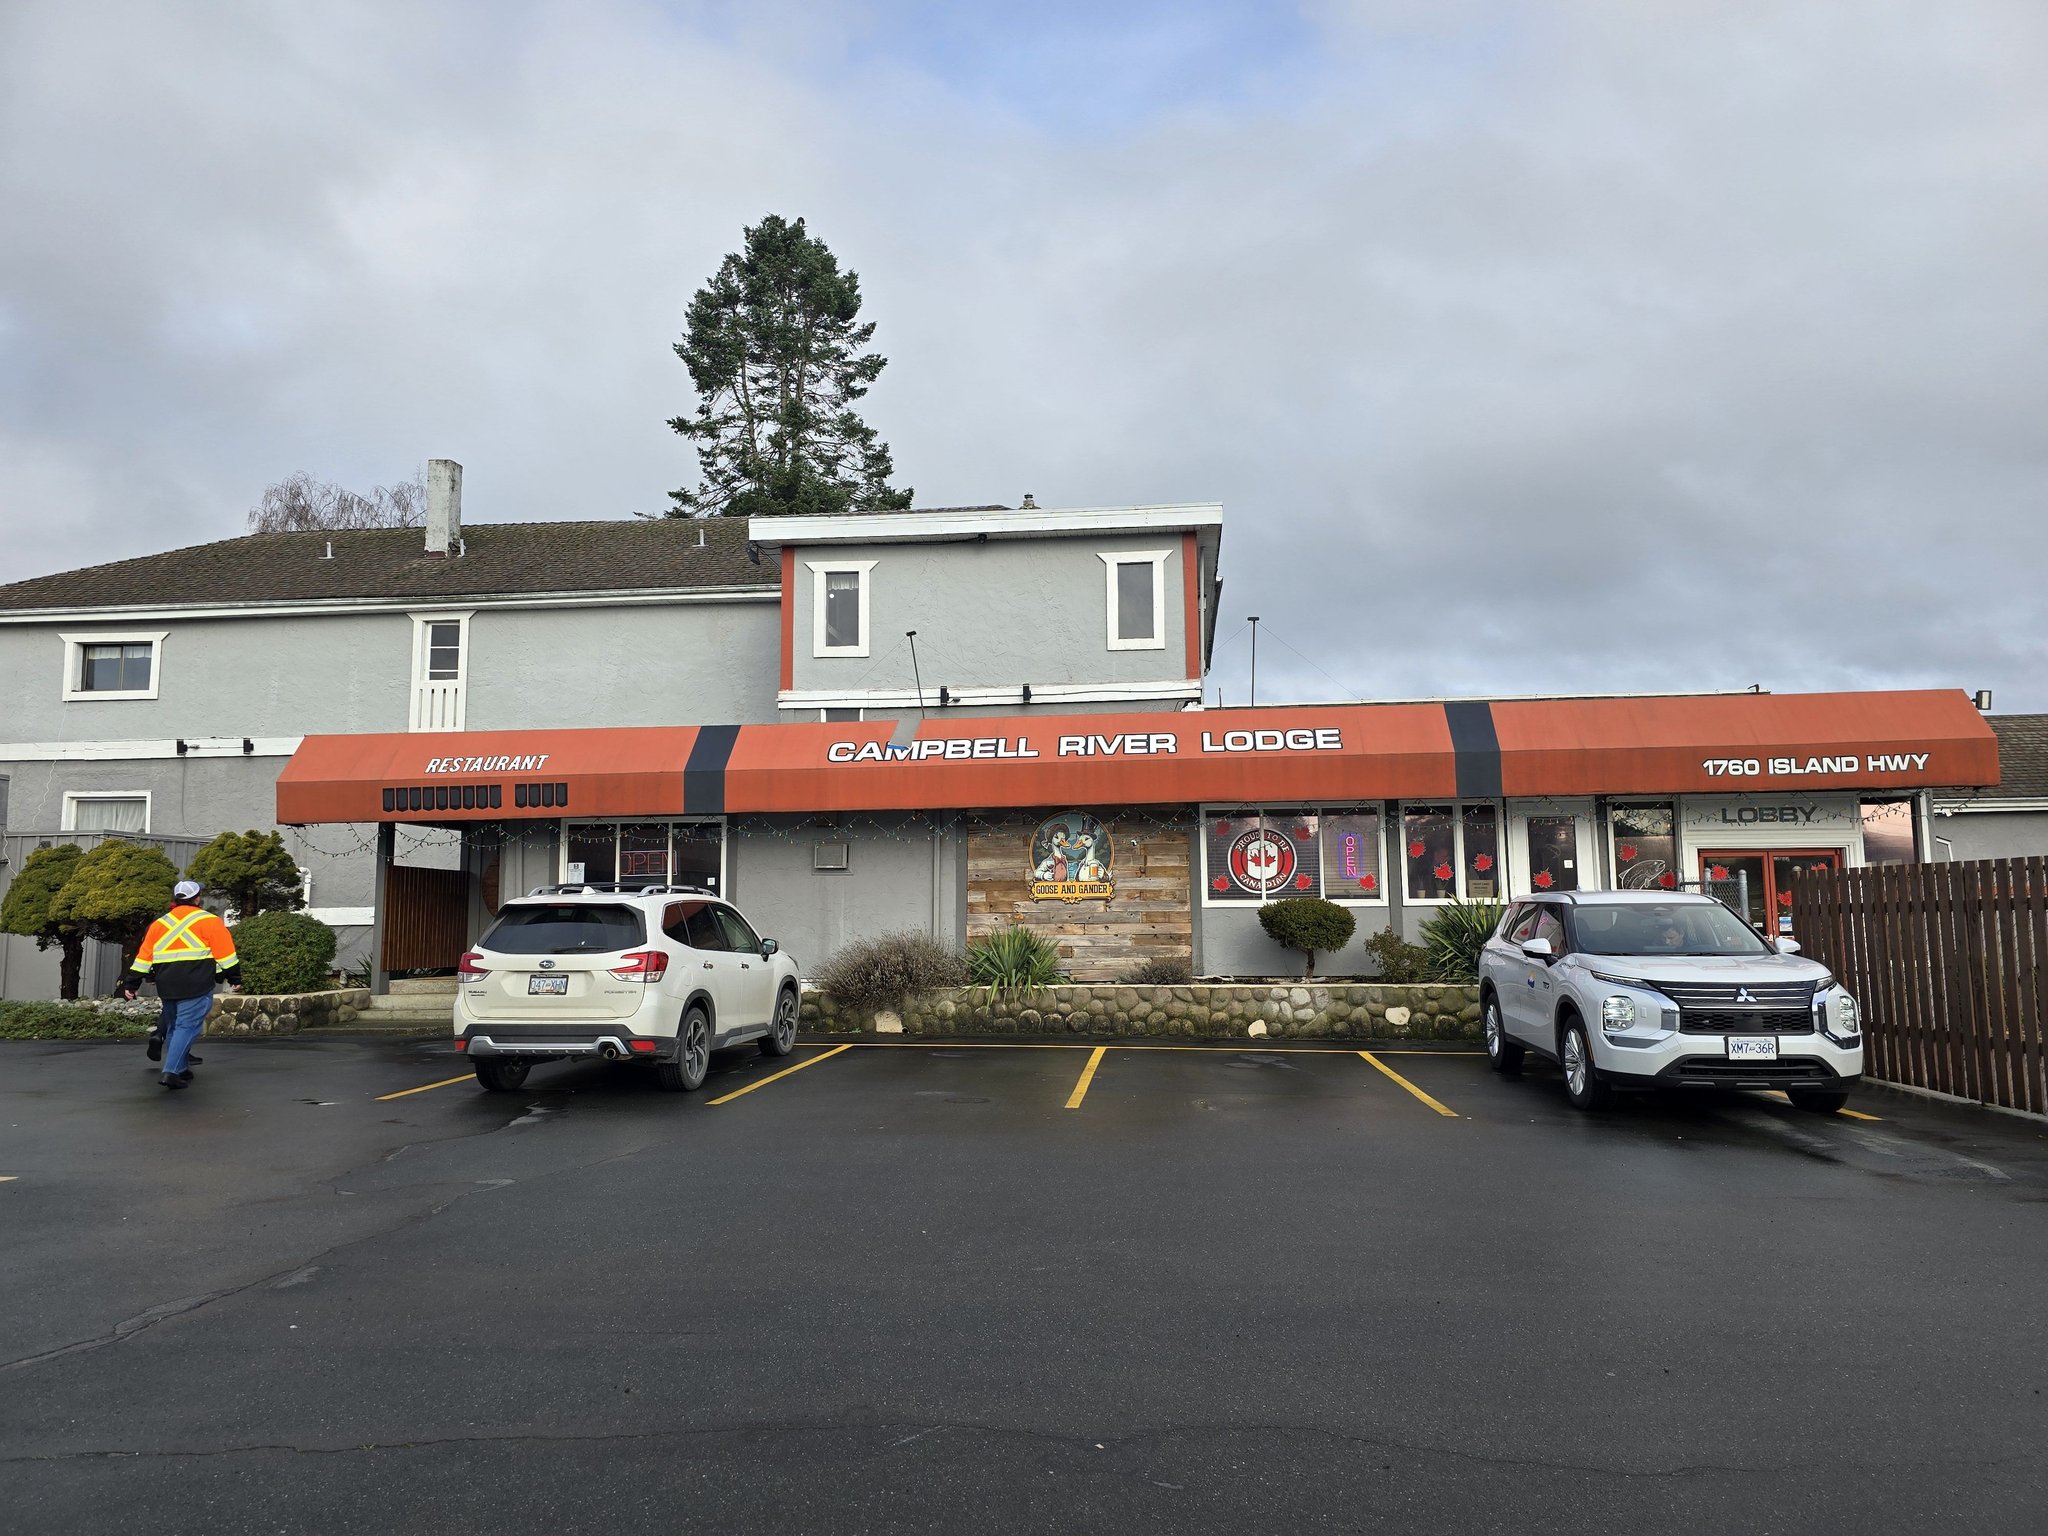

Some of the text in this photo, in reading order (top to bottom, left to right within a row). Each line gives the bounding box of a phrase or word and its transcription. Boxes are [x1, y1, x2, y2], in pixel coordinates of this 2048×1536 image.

[827, 728, 1343, 762] CAMPBELL RIVER LODGE
[424, 754, 550, 774] RESTAURANT
[1702, 752, 1930, 776] 1760 ISLAND HWY
[1721, 806, 1817, 824] LOBBY
[1266, 832, 1279, 841] TO
[1278, 840, 1290, 853] BE
[1345, 836, 1357, 877] OPEN
[1036, 884, 1108, 894] GOOSE AND GANDER
